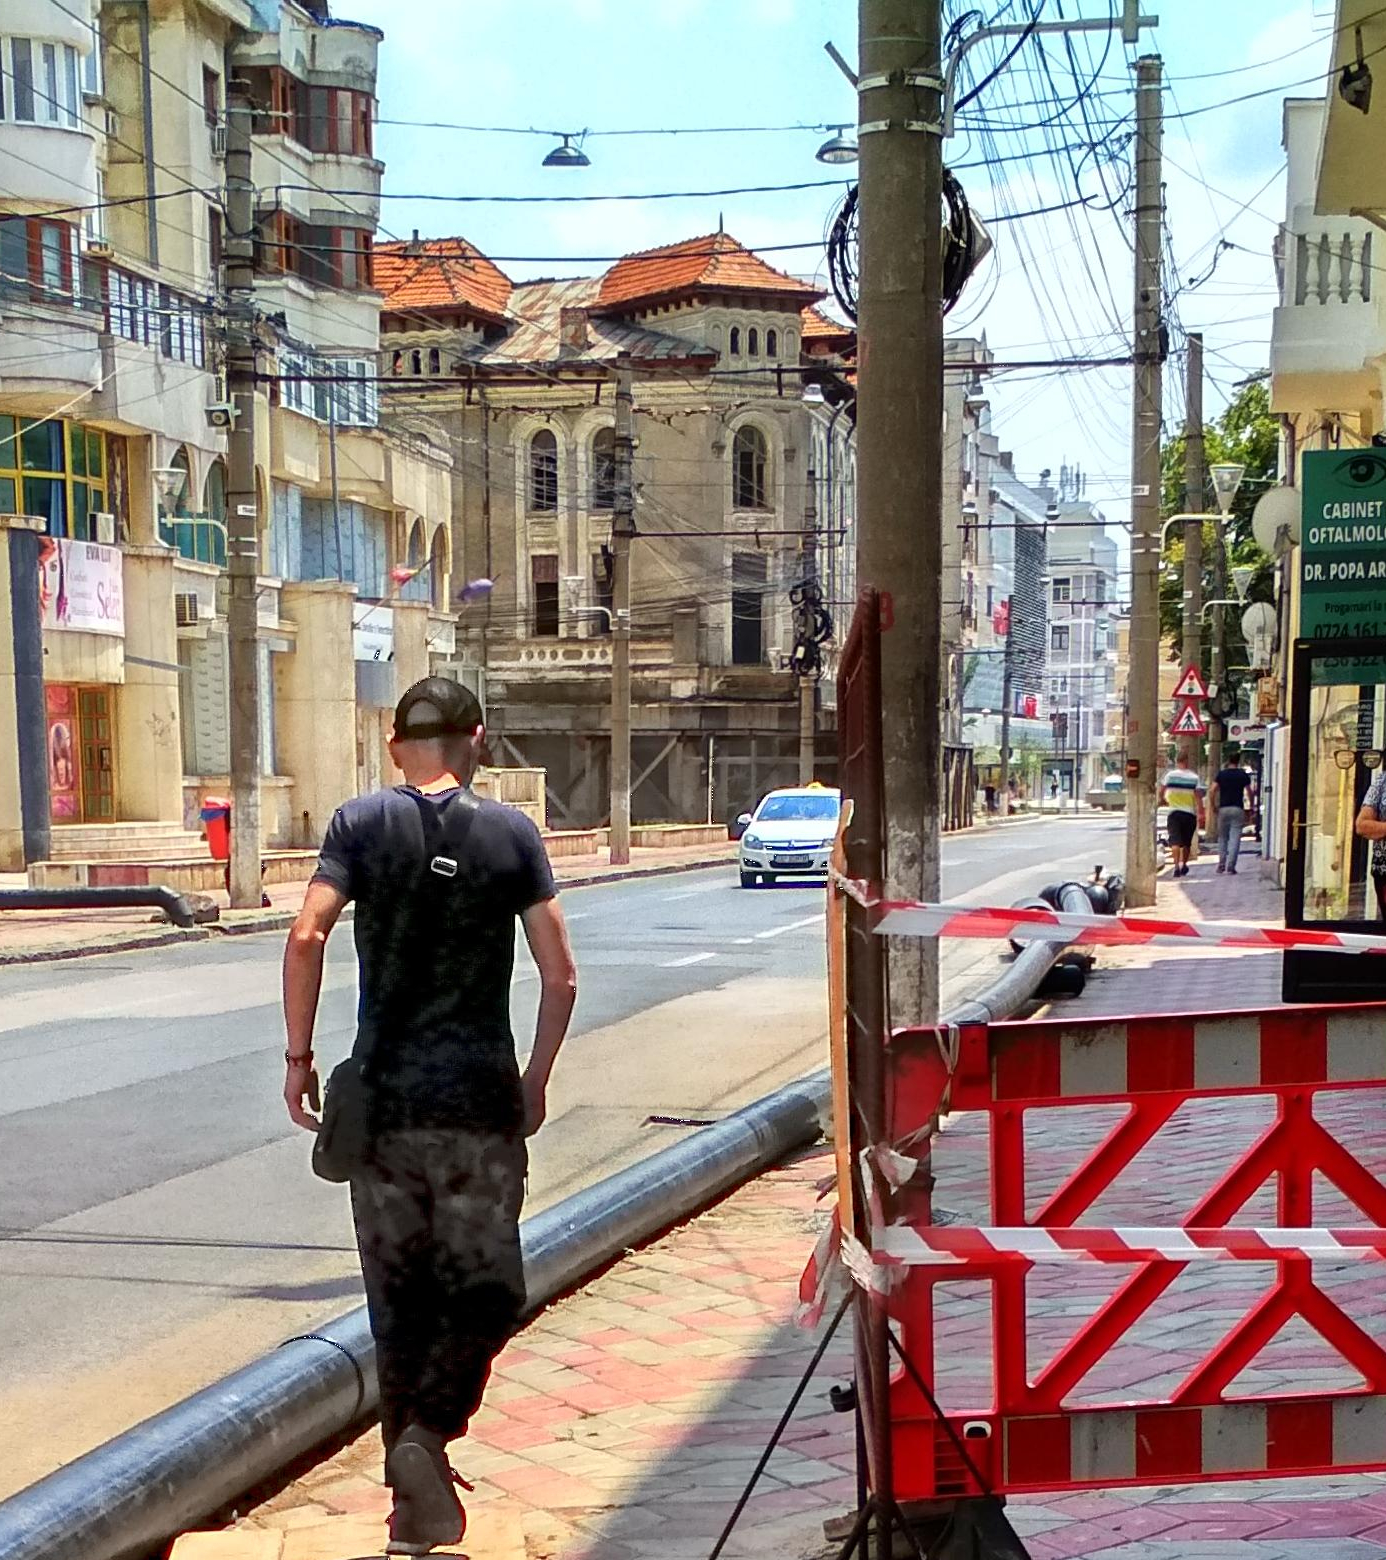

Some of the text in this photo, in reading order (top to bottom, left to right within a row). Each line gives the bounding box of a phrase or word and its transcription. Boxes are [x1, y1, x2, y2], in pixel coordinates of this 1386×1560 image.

[1322, 501, 1382, 520] CABINET
[1304, 563, 1326, 581] DR.
[1330, 561, 1365, 580] POPA
[1353, 622, 1378, 638] 161
